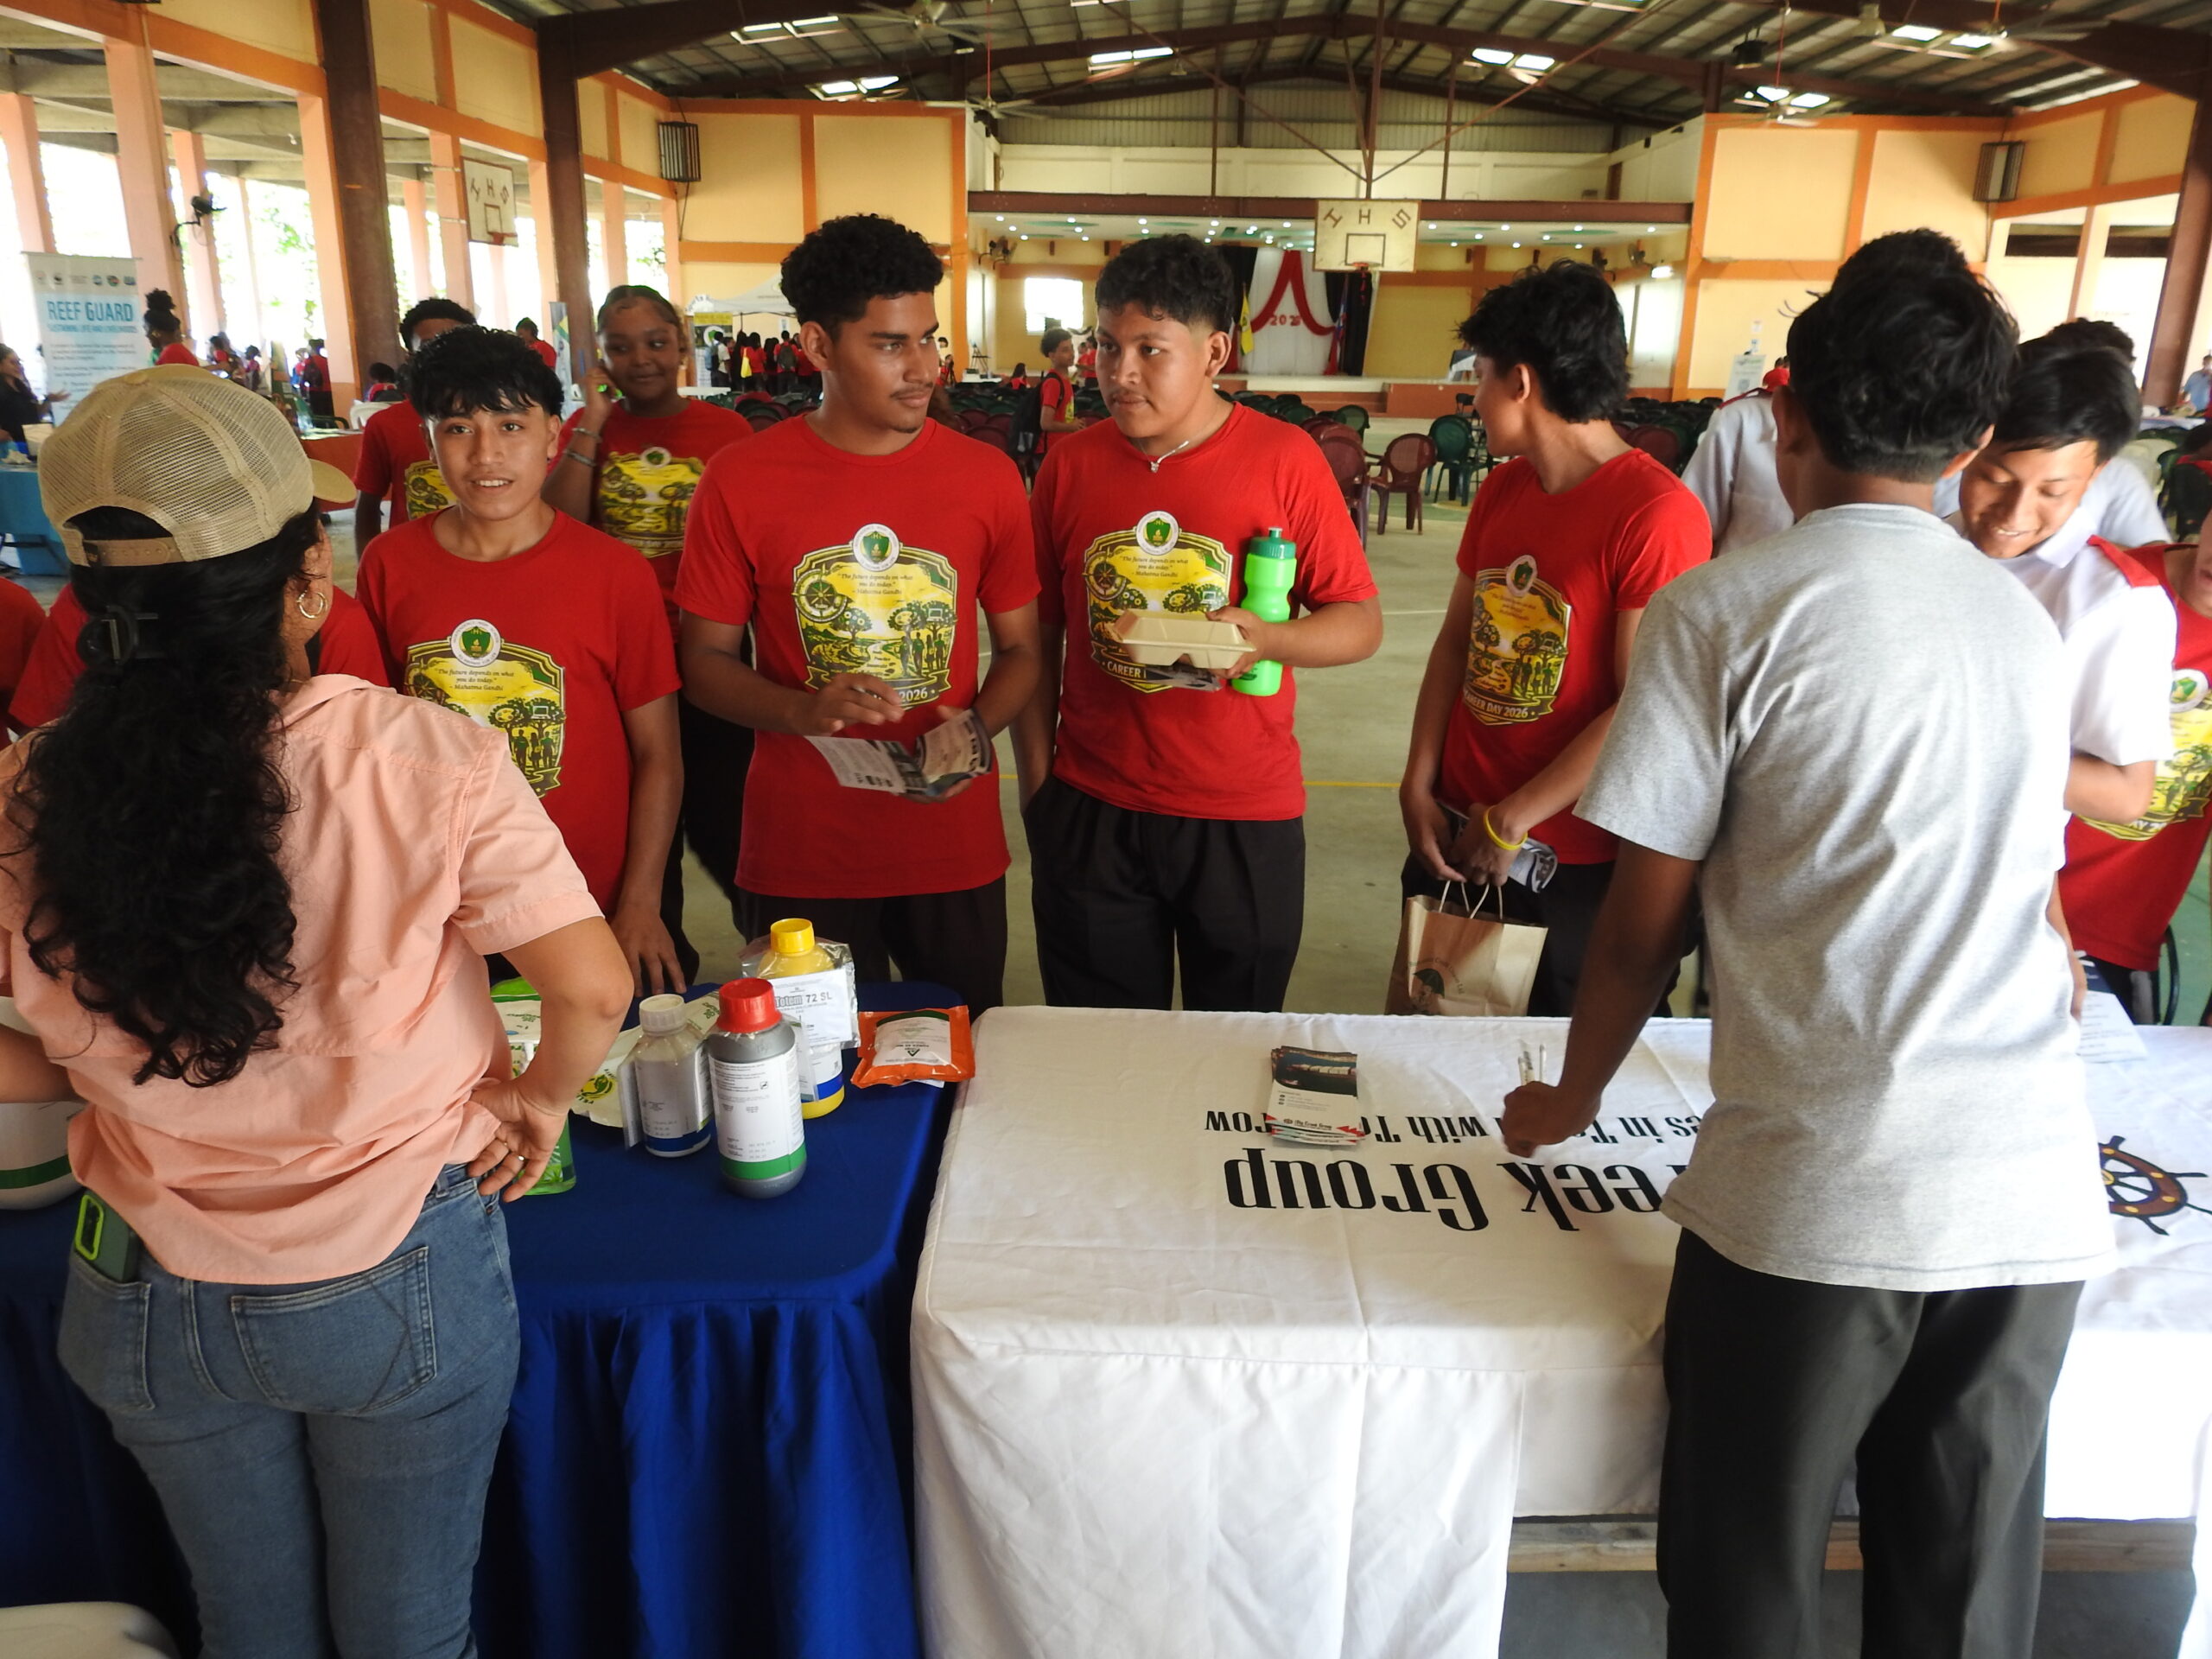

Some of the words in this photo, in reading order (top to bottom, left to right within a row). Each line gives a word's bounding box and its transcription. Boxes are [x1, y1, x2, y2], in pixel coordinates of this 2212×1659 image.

[47, 301, 80, 321] REEF
[85, 302, 134, 321] GUARD
[1107, 660, 1141, 678] CAREER
[899, 688, 928, 702] 2026
[1486, 702, 1503, 715] DAY
[1504, 707, 1529, 718] 2026
[775, 995, 803, 1007] Totem
[805, 994, 817, 1003] 72
[820, 992, 832, 1001] SL
[1405, 1116, 1490, 1143] with
[1618, 1117, 1664, 1143] in
[1224, 1147, 1489, 1231] Group
[1497, 1162, 1688, 1231] eek
